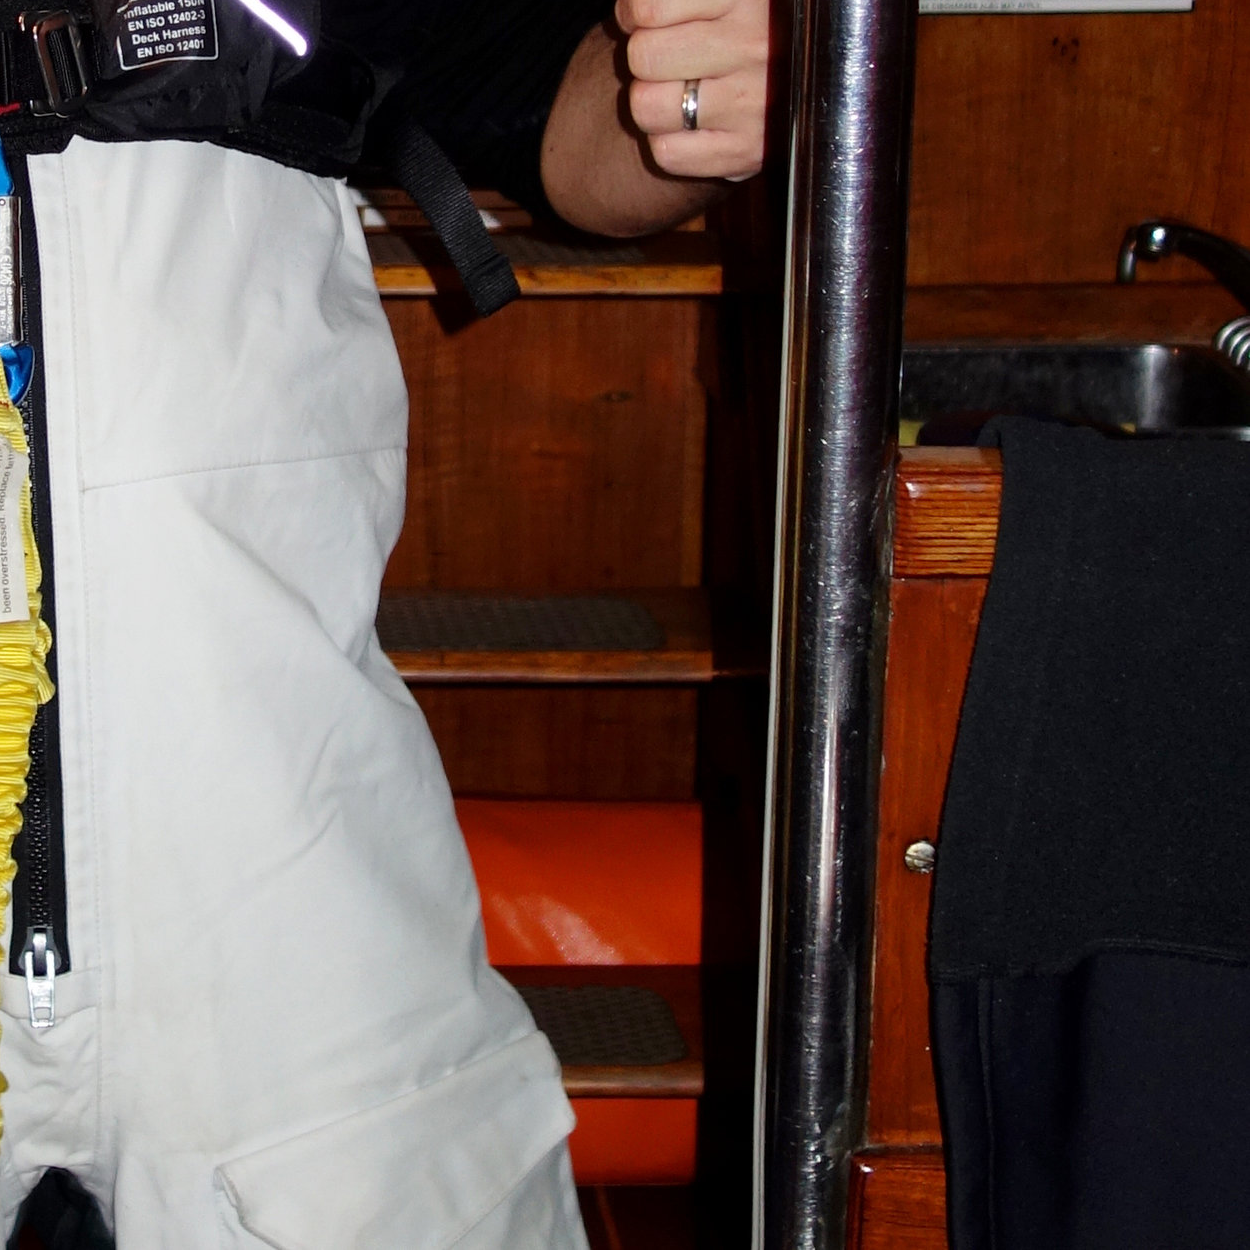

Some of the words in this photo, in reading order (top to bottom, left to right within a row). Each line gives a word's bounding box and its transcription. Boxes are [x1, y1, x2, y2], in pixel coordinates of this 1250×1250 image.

[128, 20, 144, 31] EN
[146, 16, 165, 29] ISO
[168, 10, 206, 24] 12402-3
[132, 33, 160, 45] Deck
[162, 26, 206, 40] Harness
[137, 48, 153, 58] EN
[155, 44, 174, 54] ISO
[177, 39, 204, 51] 12401
[0, 588, 11, 613] been
